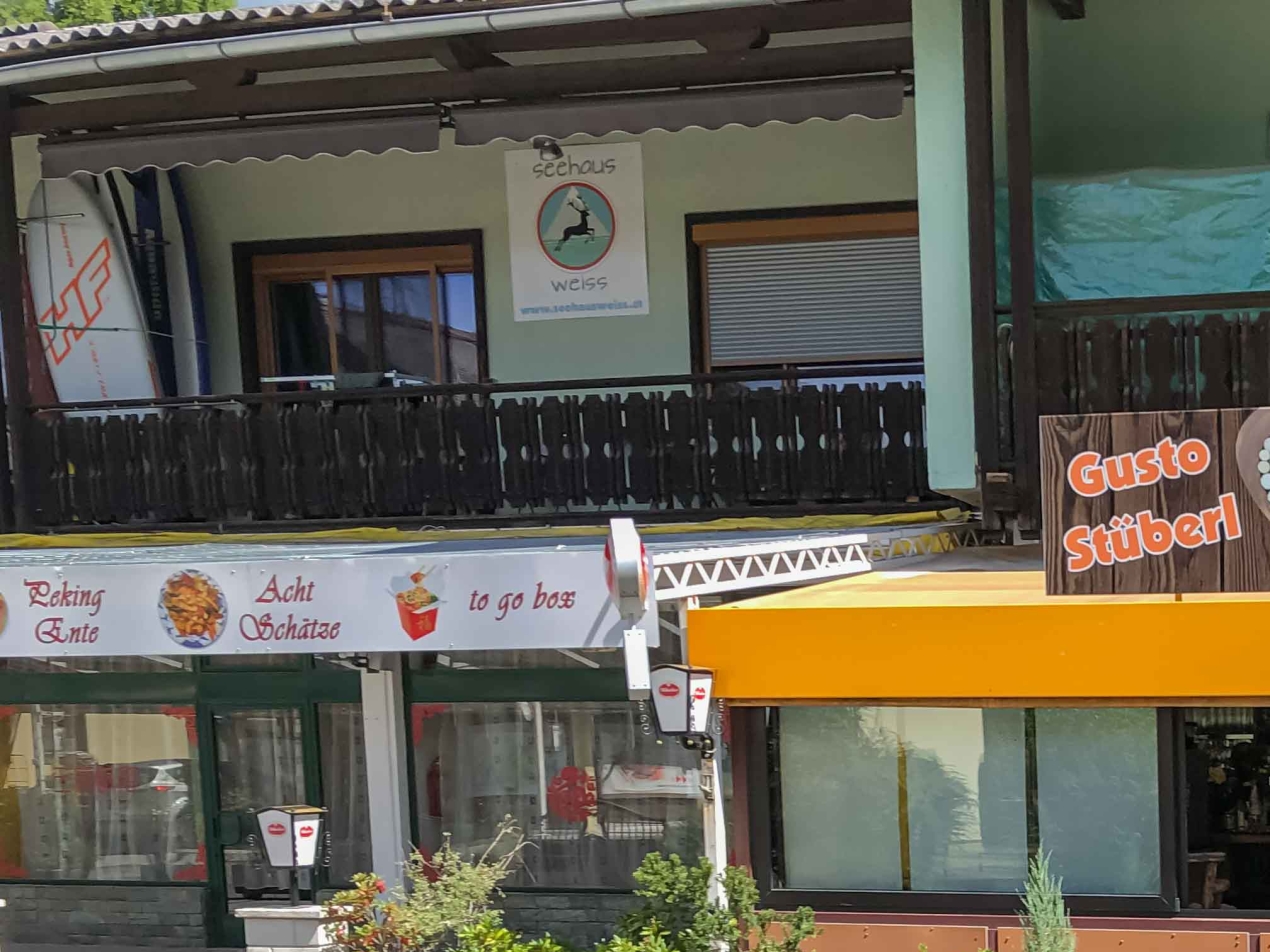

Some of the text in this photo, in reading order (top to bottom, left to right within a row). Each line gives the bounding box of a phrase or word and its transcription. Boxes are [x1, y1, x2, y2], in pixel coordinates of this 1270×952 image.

[533, 155, 616, 179] seehaus
[551, 275, 608, 293] weiss
[1067, 436, 1211, 497] Gusto
[1064, 492, 1242, 572] Stüberl
[24, 578, 105, 615] Peking
[255, 574, 314, 603] Acht
[469, 582, 575, 620] to go box
[35, 617, 99, 643] Ente
[239, 612, 341, 642] Schätze
